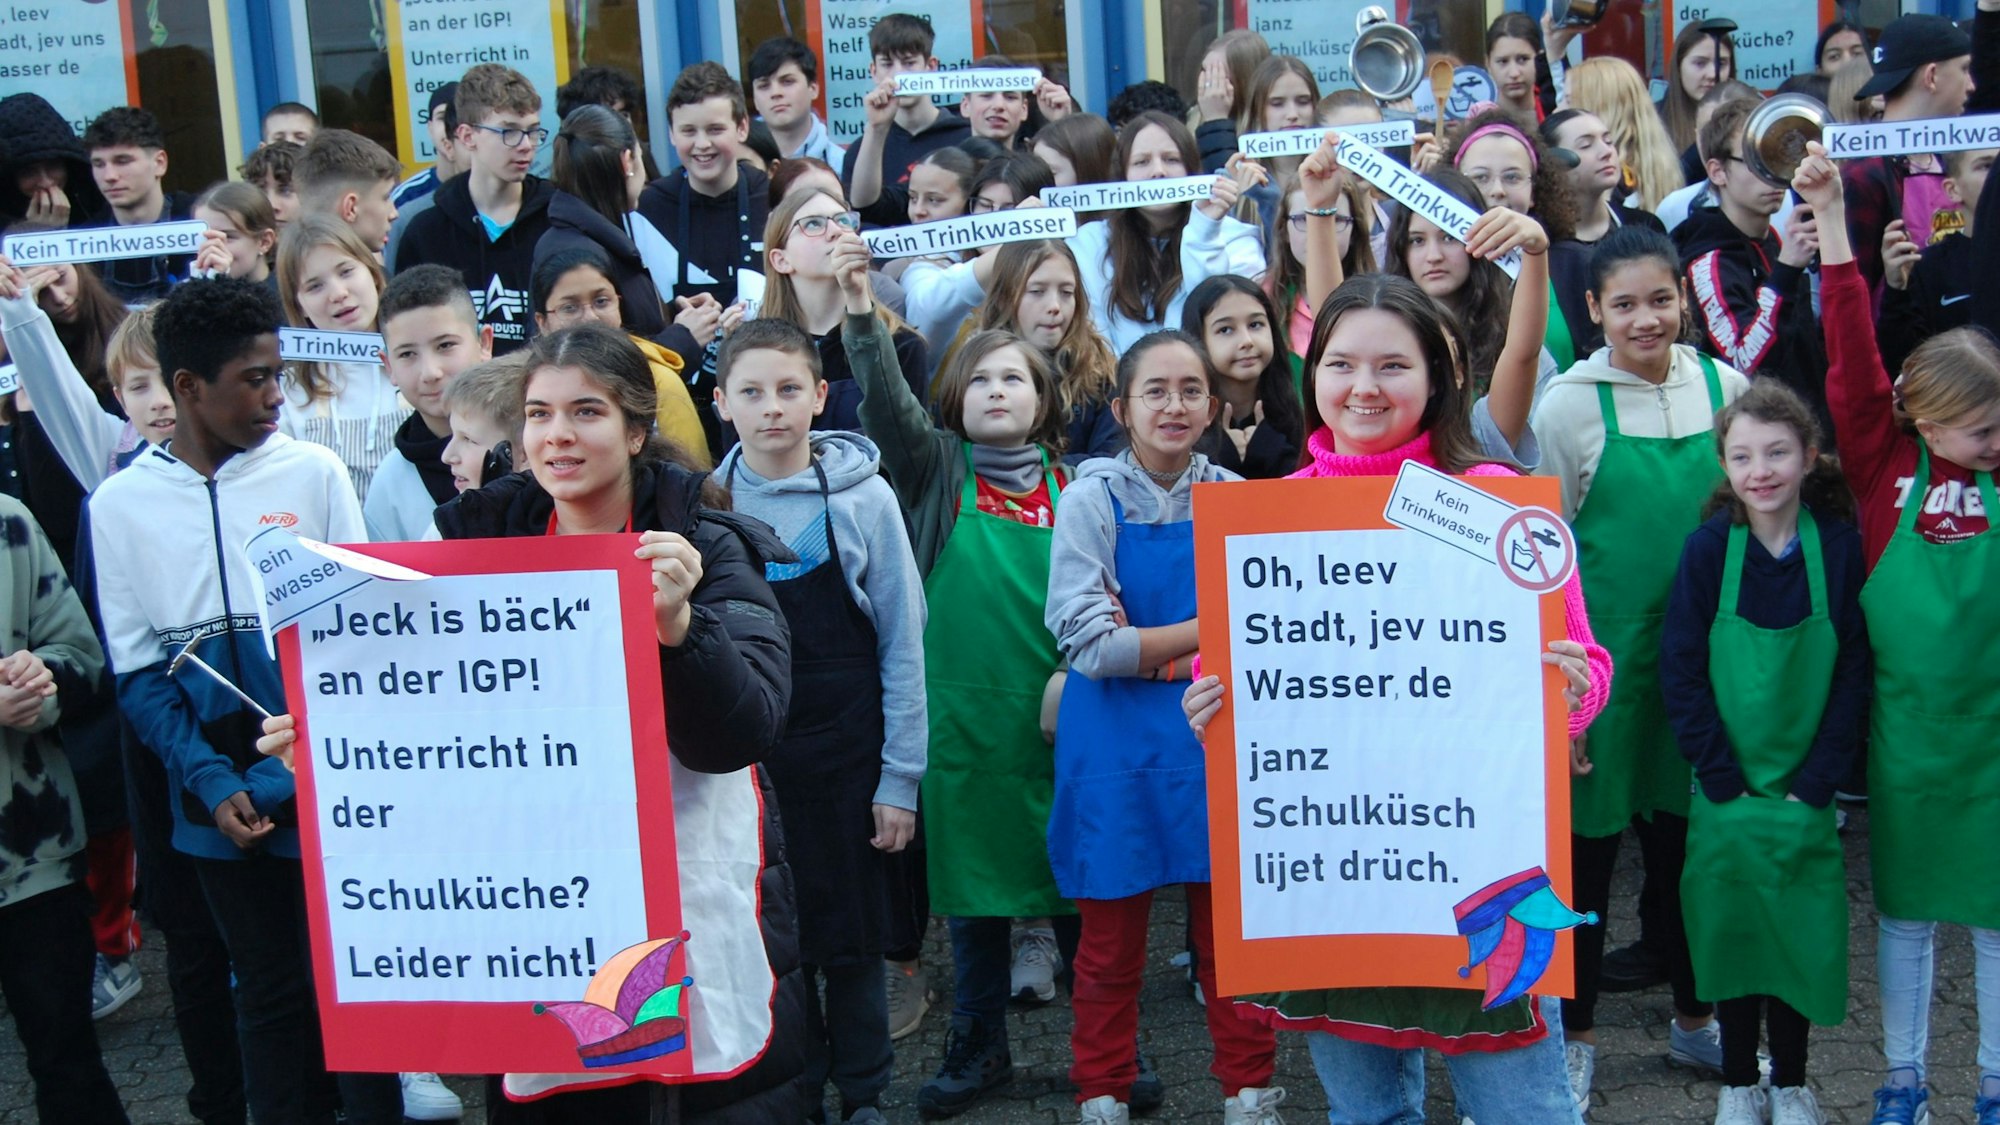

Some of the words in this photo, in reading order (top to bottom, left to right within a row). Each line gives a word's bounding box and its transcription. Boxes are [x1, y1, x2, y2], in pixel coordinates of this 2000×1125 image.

[11, 6, 49, 21] leev
[409, 20, 430, 31] an
[437, 15, 468, 30] der
[474, 12, 512, 28] IGP!
[1255, 17, 1293, 33] janz
[1680, 6, 1709, 21] der
[0, 34, 32, 51] adt,
[38, 32, 64, 52] jev
[72, 33, 105, 46] uns
[1732, 30, 1794, 49] küche?
[0, 63, 52, 78] asser
[58, 59, 79, 75] de
[411, 48, 508, 66] Unterricht
[514, 46, 530, 61] in
[1745, 58, 1795, 79] nicht!
[898, 77, 934, 92] Kein
[938, 73, 1038, 90] Trinkwasser
[1246, 136, 1287, 154] Kein
[1832, 130, 1888, 153] Kein
[1896, 123, 2000, 149] Trinkwa
[1337, 139, 1383, 179] Kein
[1048, 191, 1091, 209] Kein
[11, 242, 60, 261] Kein
[66, 232, 200, 256] Trinkwasser
[867, 233, 918, 255] Kein
[923, 214, 1067, 250] Trinkwasser
[292, 334, 382, 359] Trinkwa
[1435, 489, 1470, 515] Kein
[1400, 496, 1492, 547] Trinkwasser
[258, 548, 293, 575] ein
[1242, 555, 1303, 593] Oh,
[1318, 554, 1398, 586] leev
[430, 601, 464, 635] is
[1245, 610, 1356, 647] Stadt,
[1369, 609, 1425, 650] jev
[1439, 618, 1507, 643] uns
[318, 670, 363, 696] an
[379, 661, 443, 695] der
[459, 657, 540, 693] IGP!
[1408, 666, 1452, 699] de
[325, 734, 529, 770] Unterricht
[543, 733, 579, 767] in
[1249, 741, 1330, 782] janz
[332, 795, 395, 828] der
[1252, 793, 1476, 829] Schulküsch
[1255, 851, 1325, 891] lijet
[1339, 848, 1459, 884] drüch.
[341, 875, 590, 911] Schulküche?
[348, 944, 472, 979] Leider
[487, 936, 597, 978] nicht!
